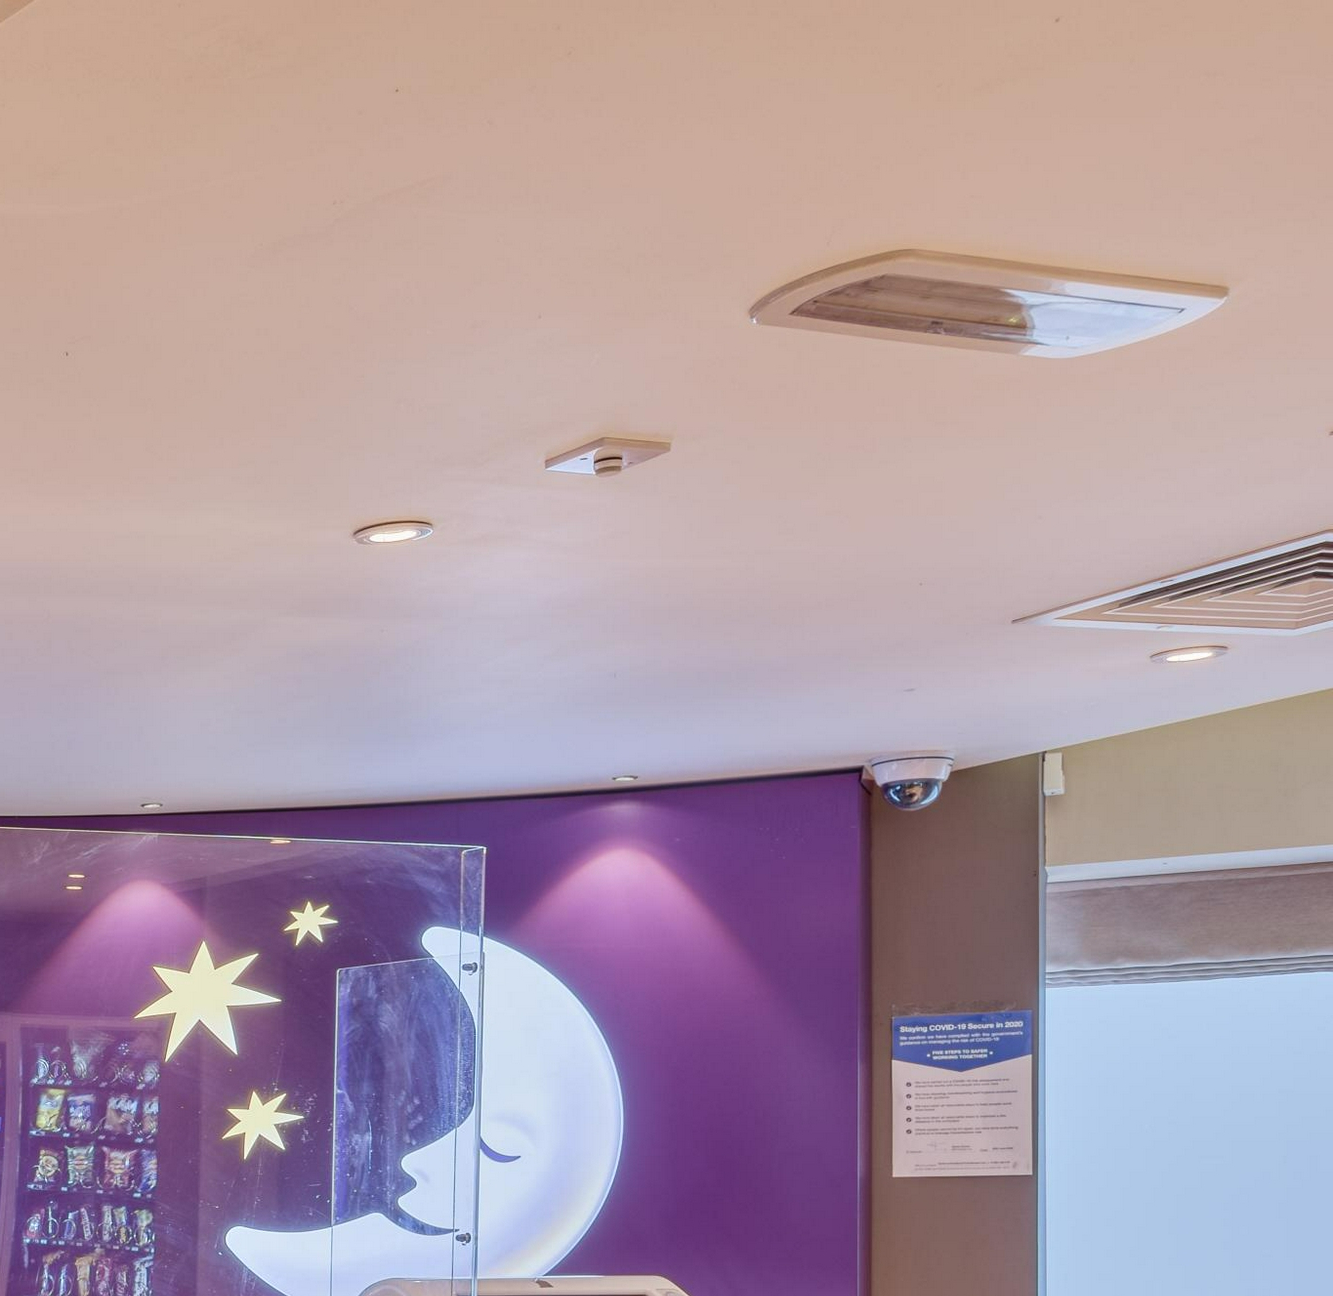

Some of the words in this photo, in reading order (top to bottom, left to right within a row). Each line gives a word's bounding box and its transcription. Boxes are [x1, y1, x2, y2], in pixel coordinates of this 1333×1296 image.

[900, 1025, 927, 1033] Staying
[928, 1023, 966, 1032] COVID-19
[967, 1022, 994, 1030] Secure
